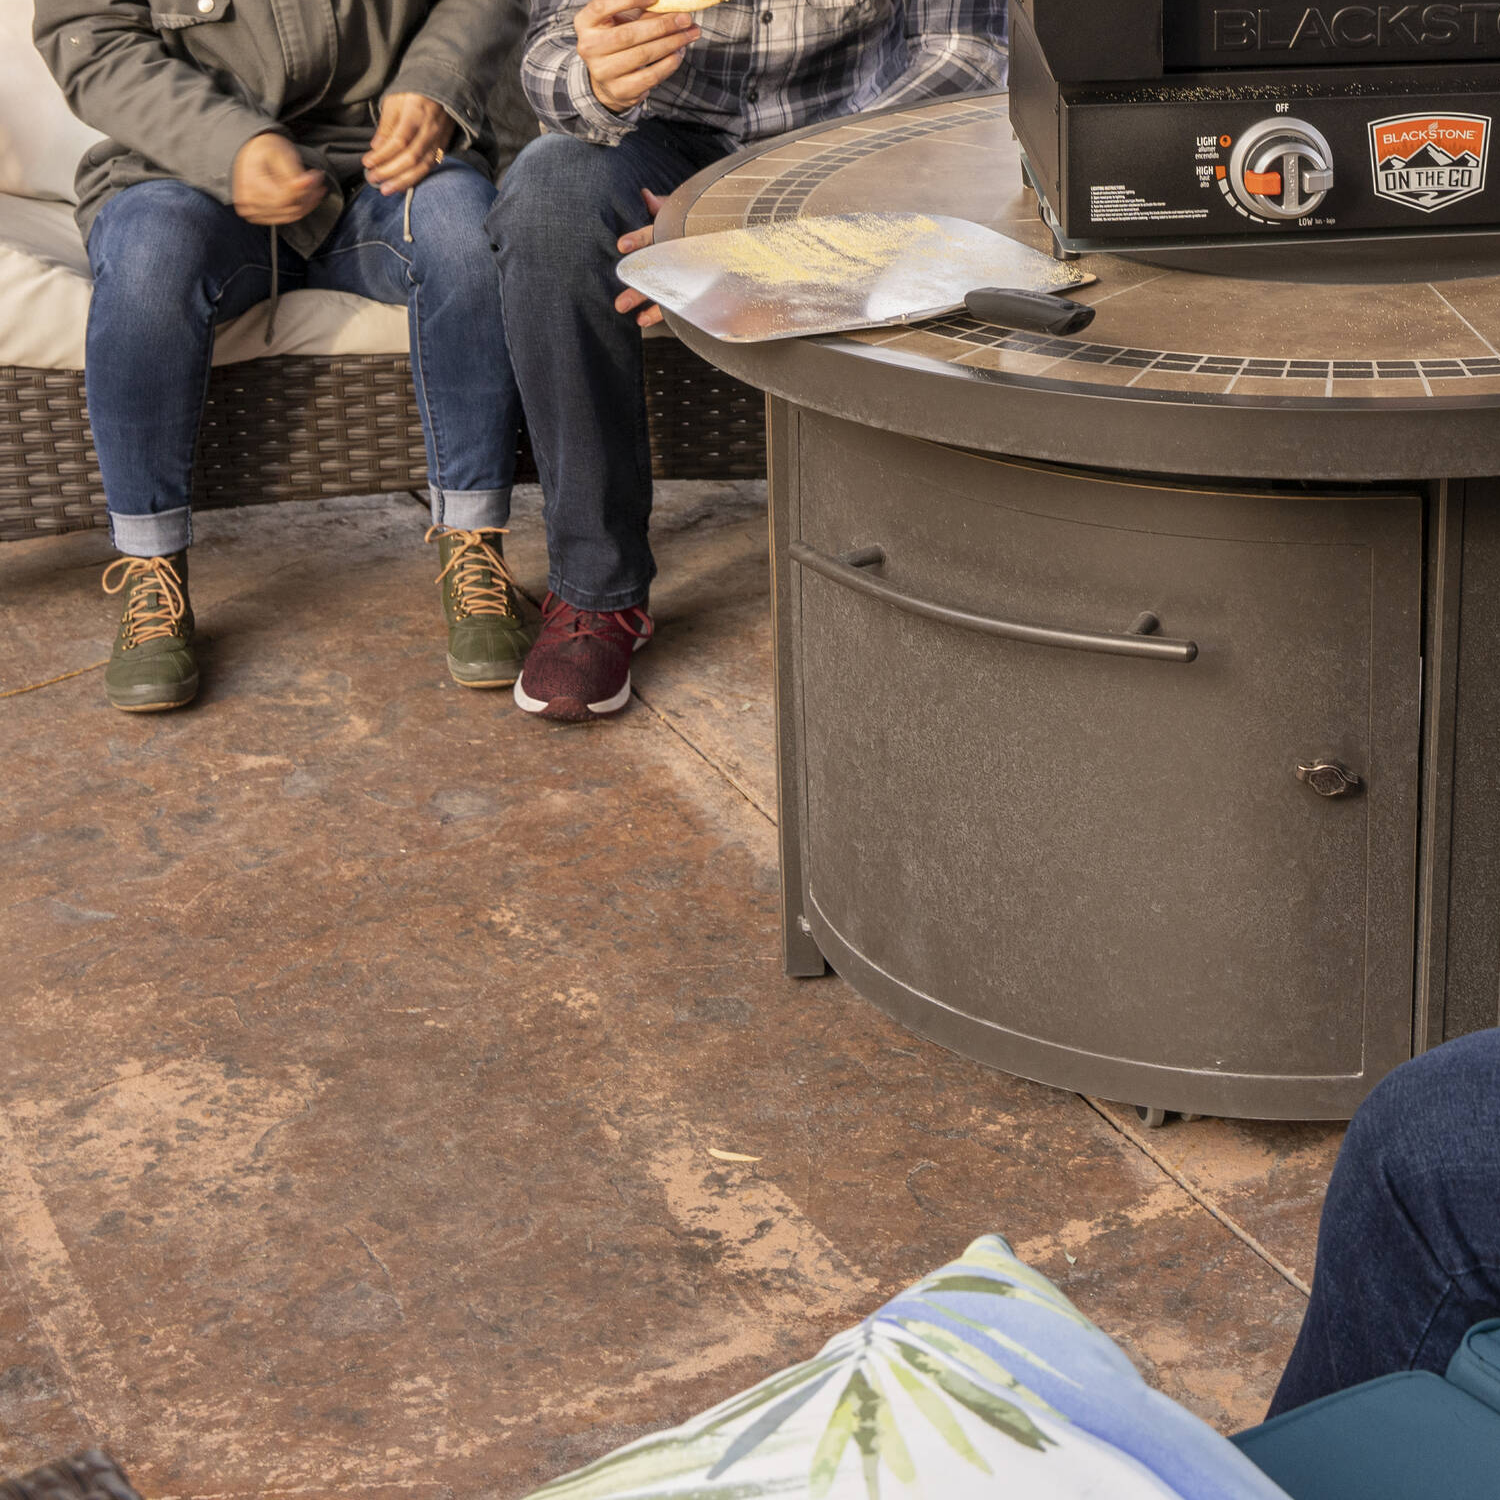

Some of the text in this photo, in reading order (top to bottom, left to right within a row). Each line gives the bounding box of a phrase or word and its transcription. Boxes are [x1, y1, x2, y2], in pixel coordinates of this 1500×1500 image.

[1275, 103, 1290, 113] OFF
[1196, 136, 1217, 146] LIGHT
[1383, 129, 1475, 144] BLACKSTONE
[1195, 165, 1214, 176] HIGH
[1385, 169, 1472, 190] ON THE GO
[1298, 218, 1313, 226] LOW
